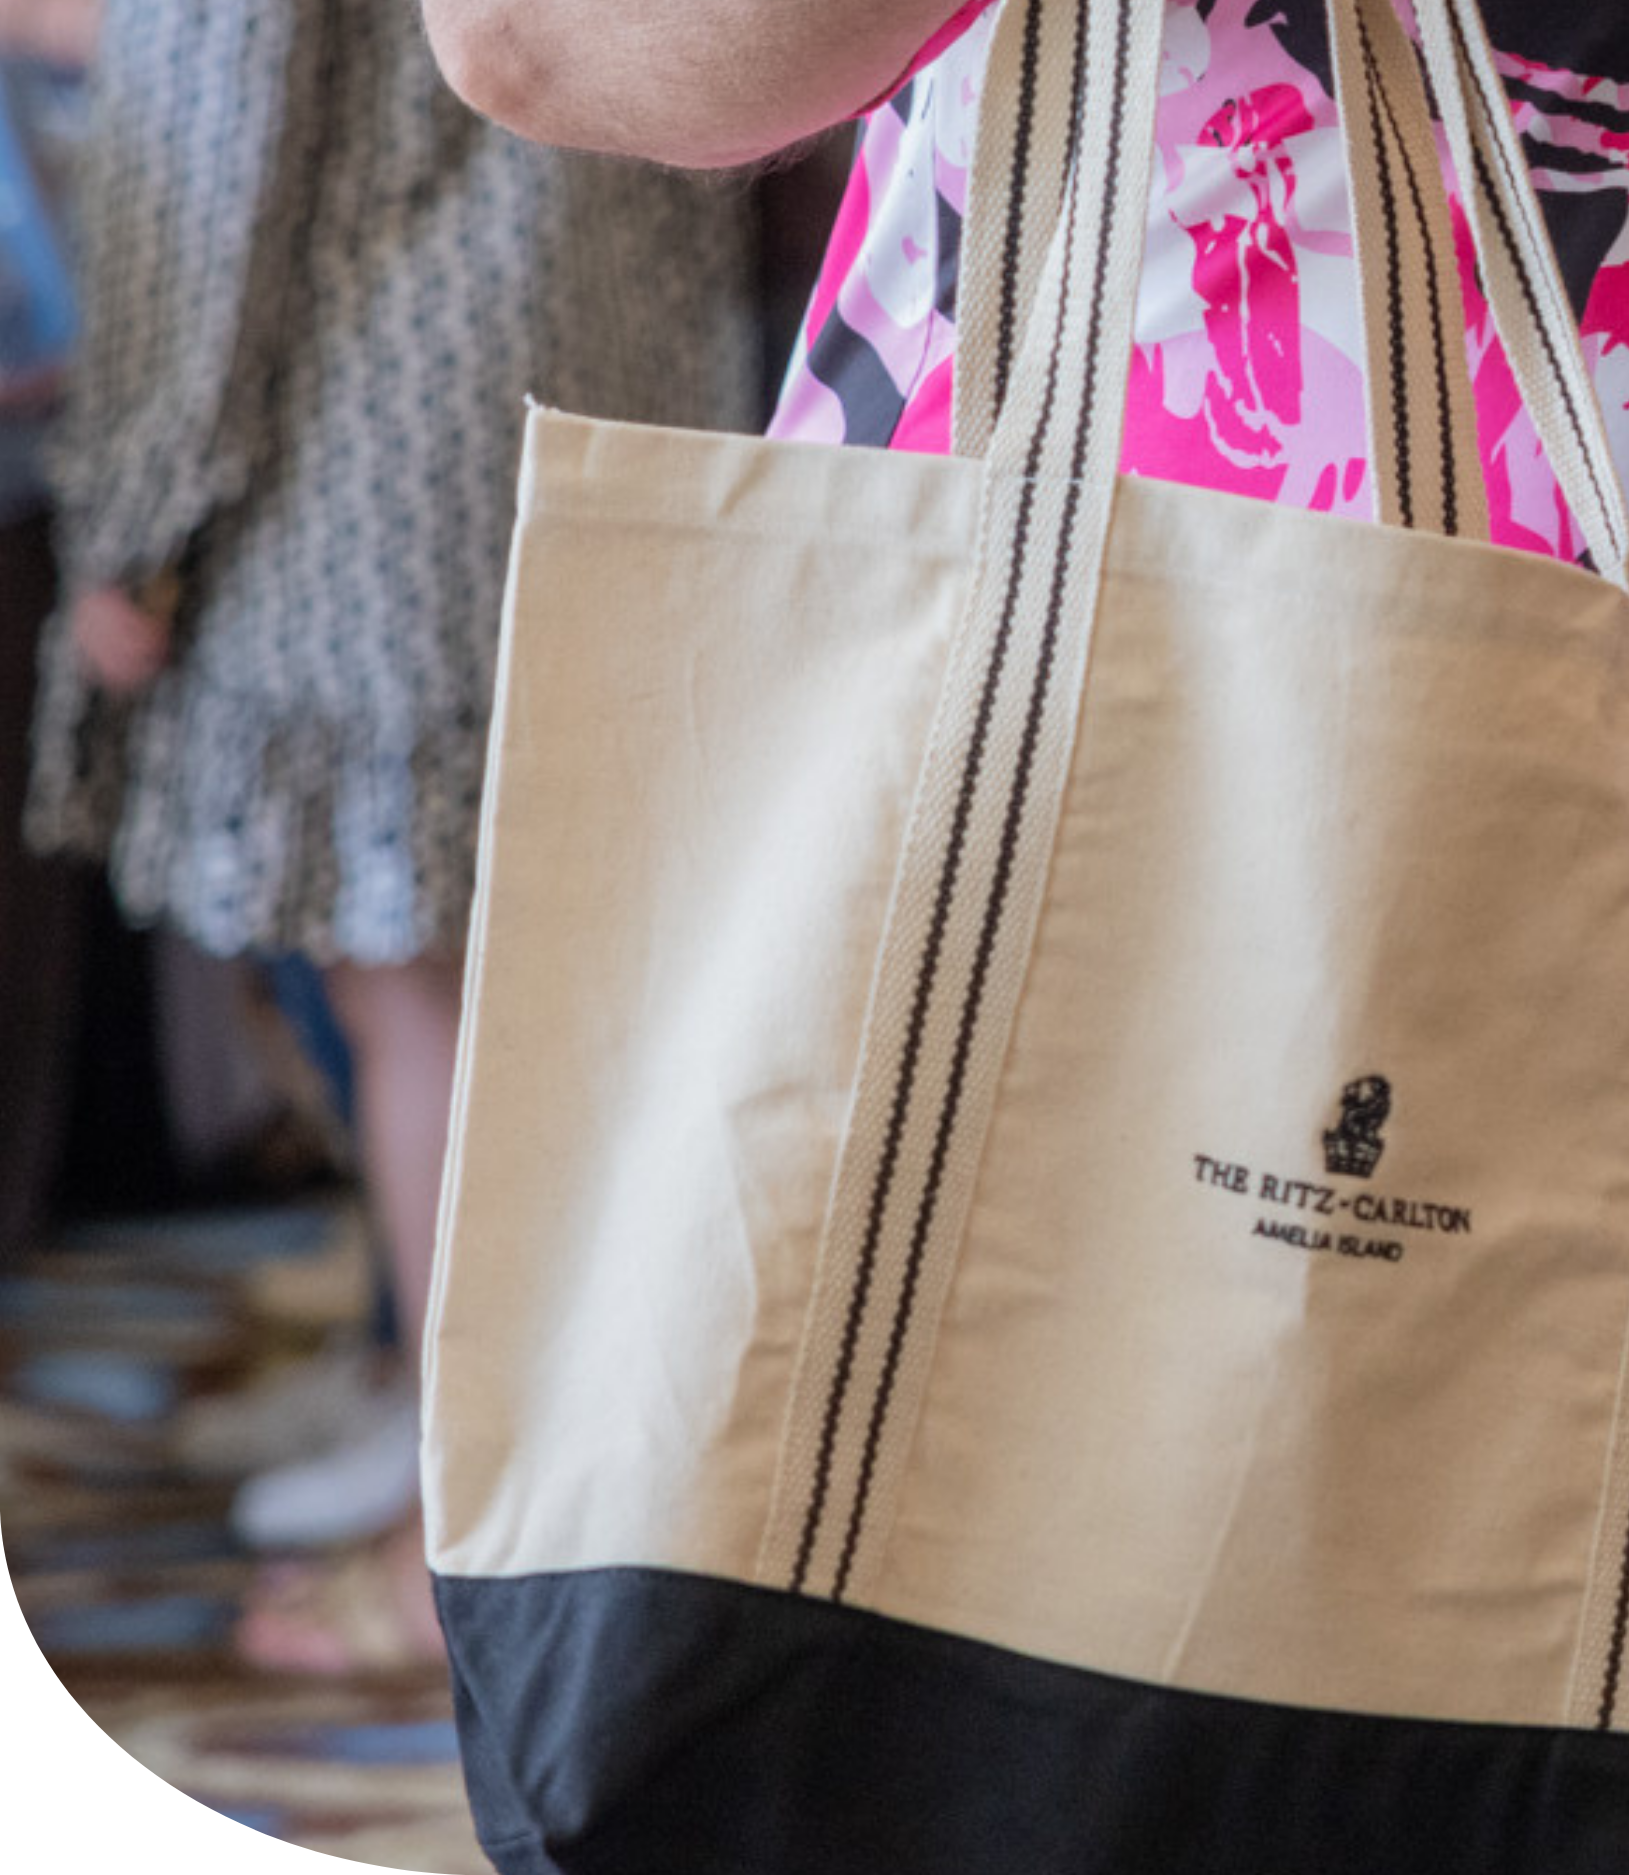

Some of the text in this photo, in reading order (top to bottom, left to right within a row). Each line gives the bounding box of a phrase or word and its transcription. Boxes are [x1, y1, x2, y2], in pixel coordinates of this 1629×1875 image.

[1193, 1153, 1249, 1194] THE
[1252, 1218, 1406, 1264] AMELIA ISLAND
